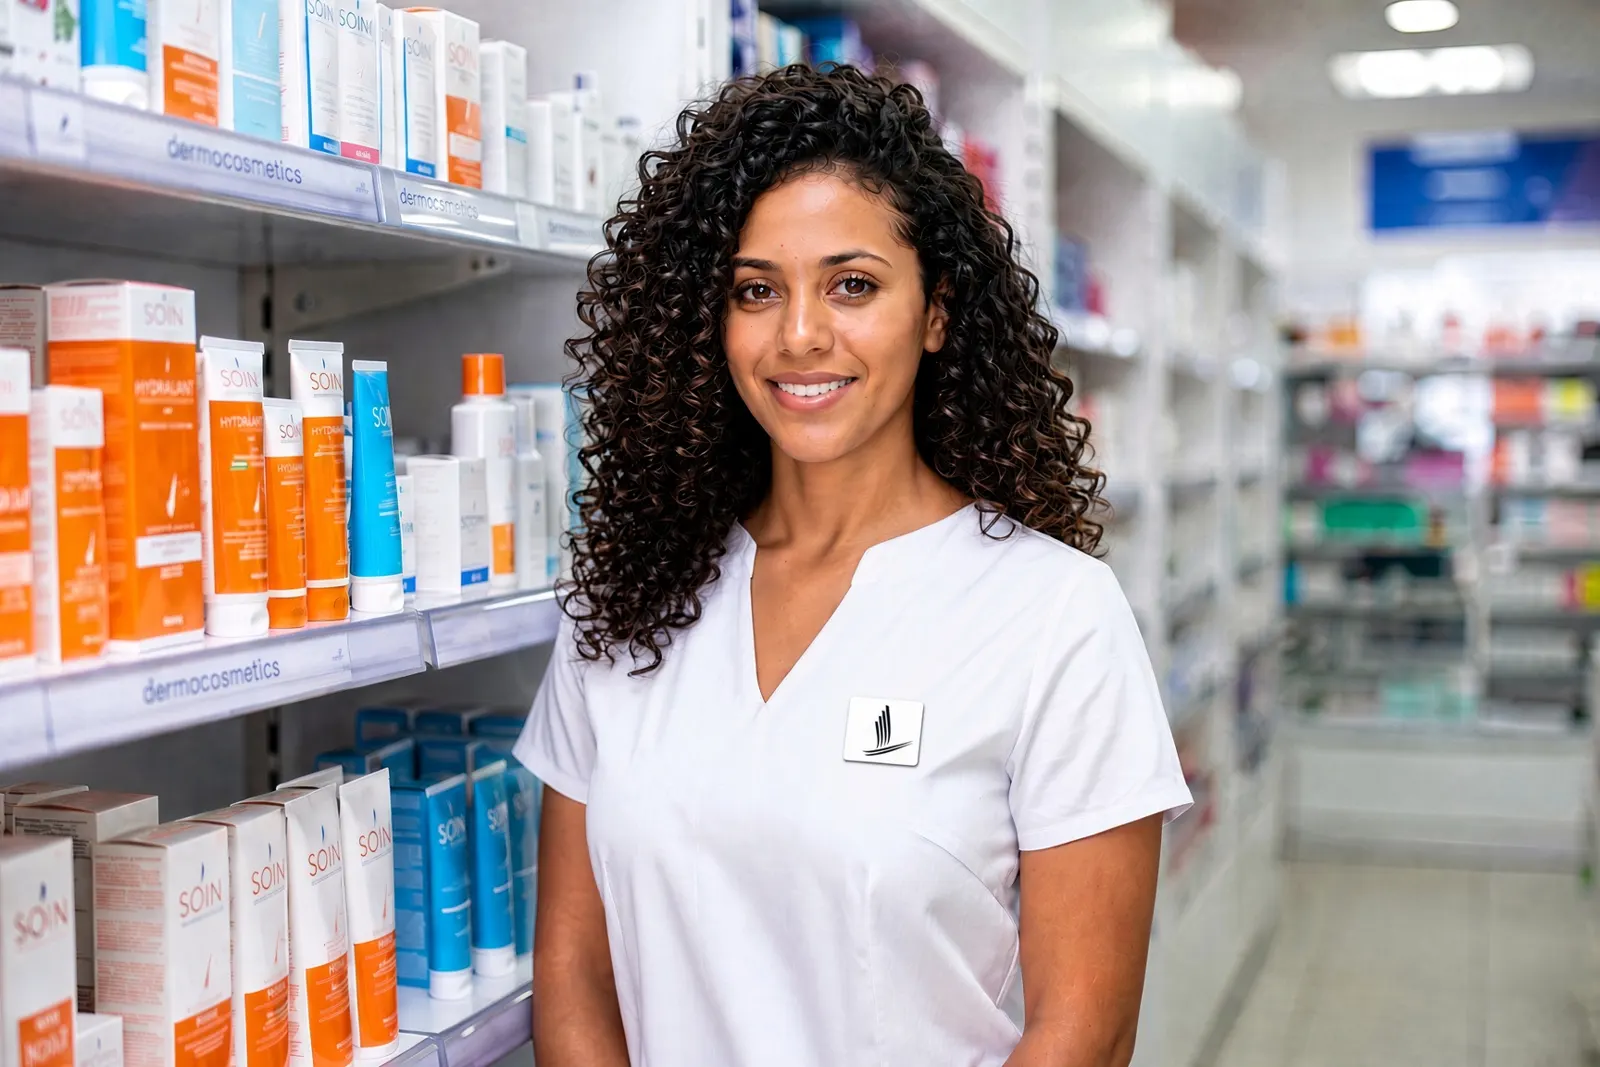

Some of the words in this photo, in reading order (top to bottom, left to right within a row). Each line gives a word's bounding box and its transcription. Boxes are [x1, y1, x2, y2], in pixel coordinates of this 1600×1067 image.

[166, 134, 303, 184] dermocosmetics
[143, 303, 184, 327] SOIN
[220, 370, 259, 388] SOIN
[309, 372, 343, 391] SOIN
[142, 659, 280, 704] dermocosmetics
[358, 823, 392, 858] SOIN
[251, 858, 285, 895] SOIN
[308, 841, 341, 877] SOIN
[179, 878, 222, 918] SOIN
[13, 895, 69, 945] SOIN
